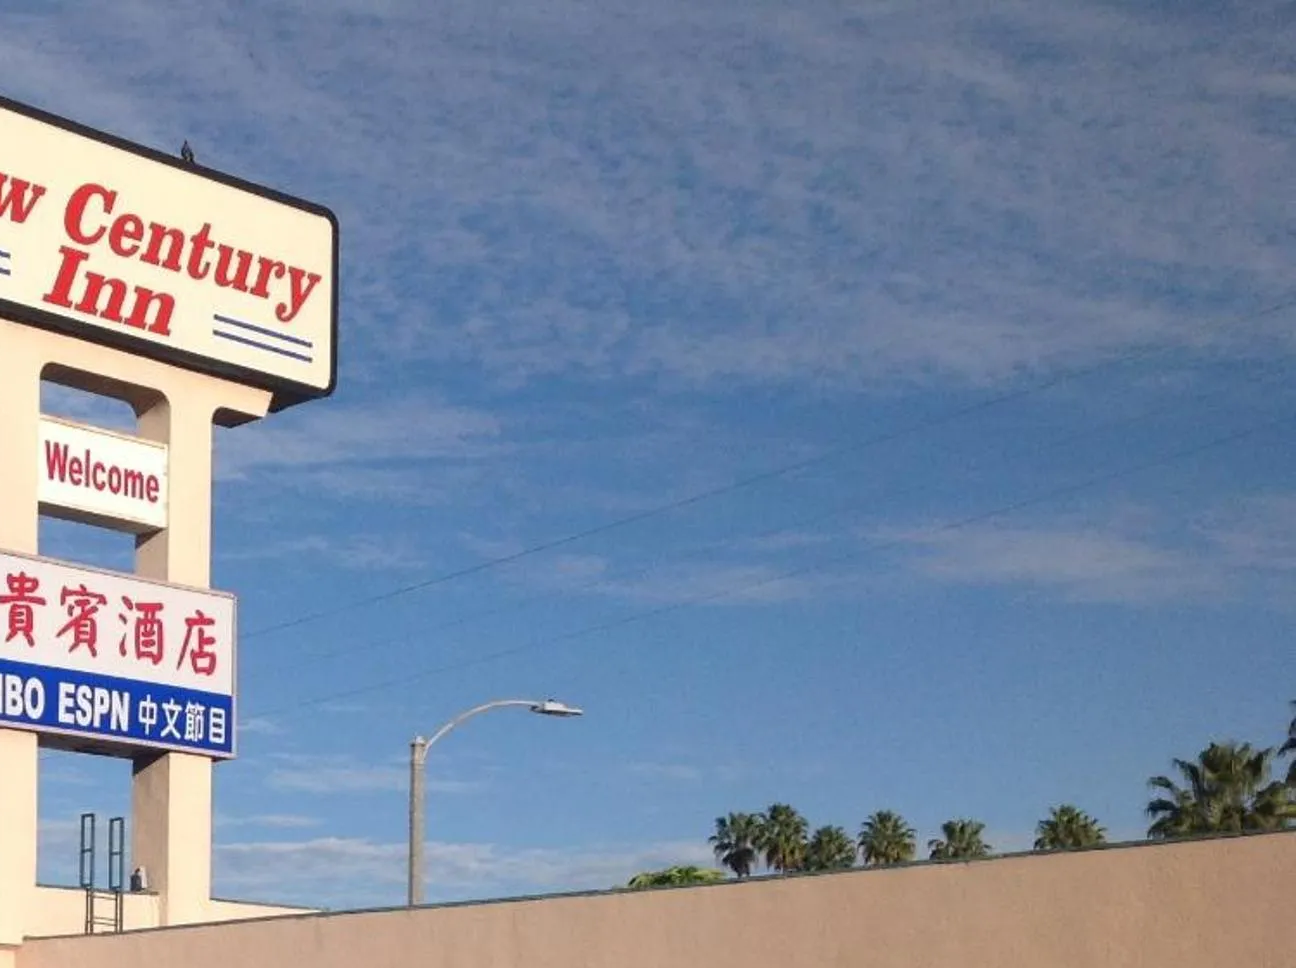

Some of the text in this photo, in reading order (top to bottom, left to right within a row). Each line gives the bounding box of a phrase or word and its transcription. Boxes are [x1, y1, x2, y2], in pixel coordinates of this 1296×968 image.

[42, 245, 176, 337] Inn
[63, 183, 322, 324] Century
[45, 439, 160, 503] Welcome
[58, 682, 129, 732] ESPN
[138, 695, 226, 743] 中文節目
